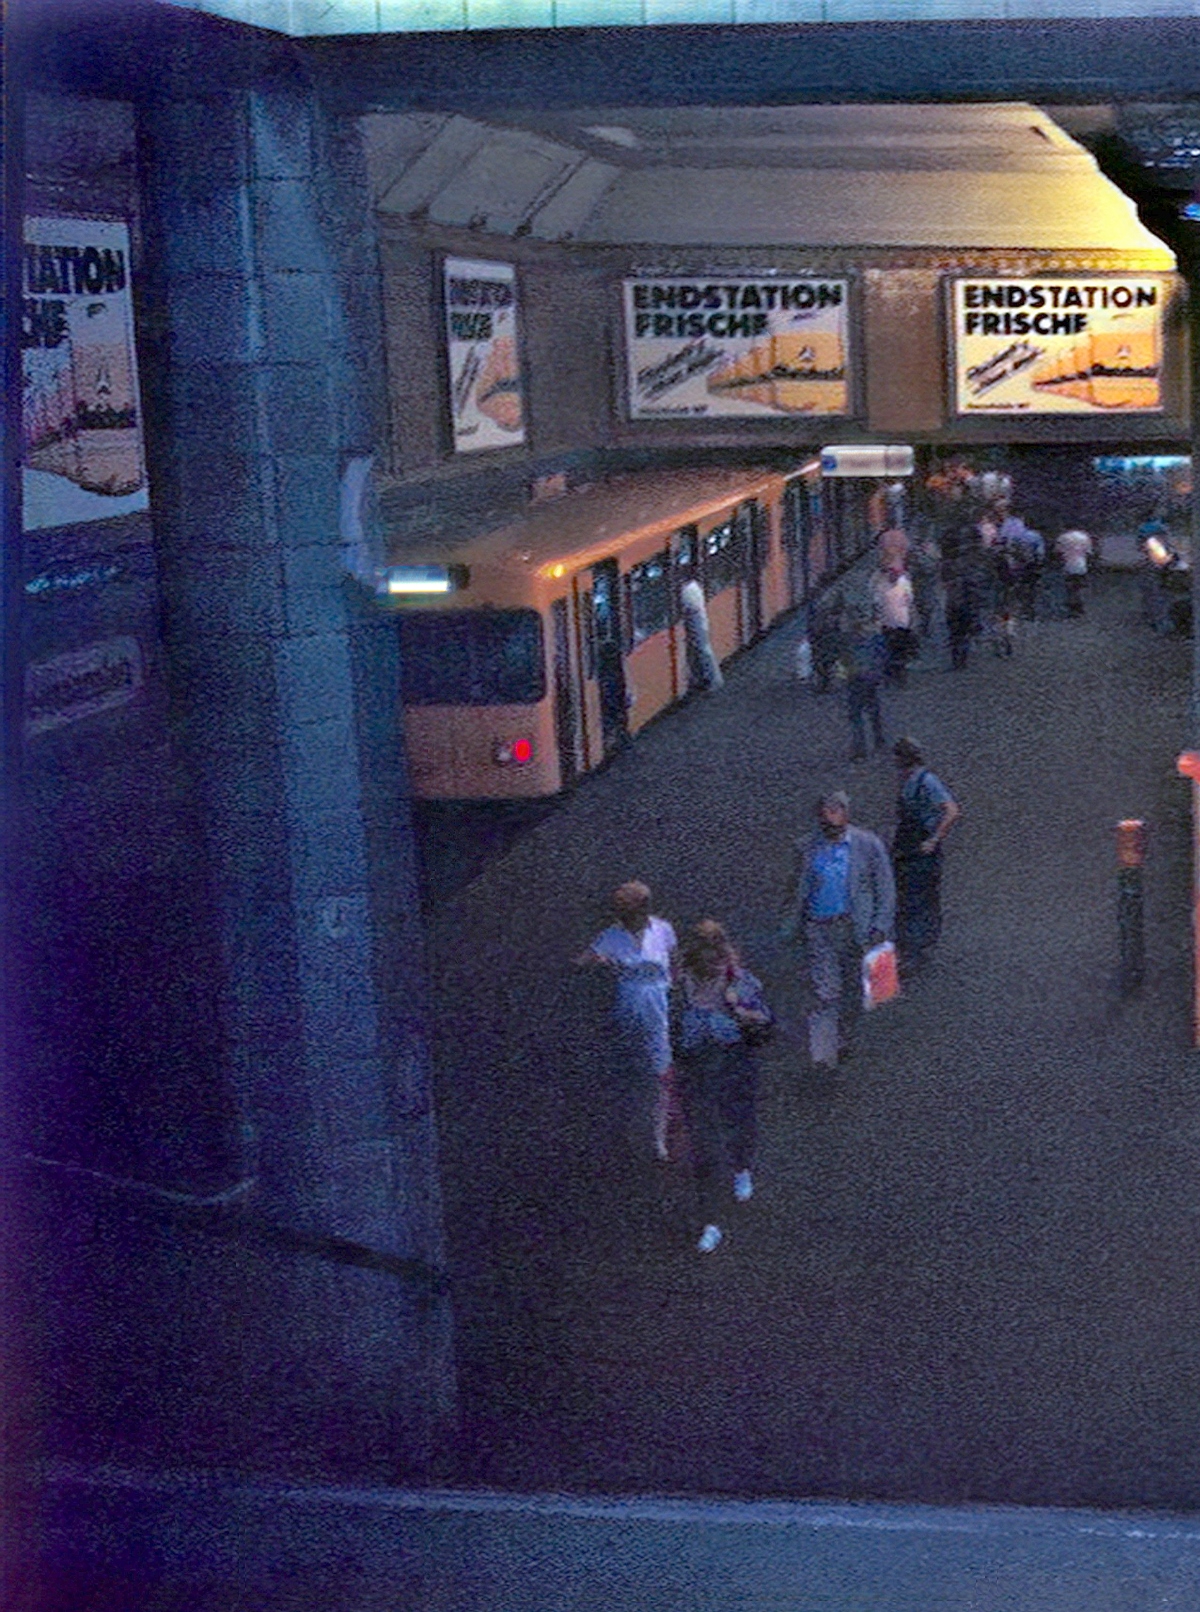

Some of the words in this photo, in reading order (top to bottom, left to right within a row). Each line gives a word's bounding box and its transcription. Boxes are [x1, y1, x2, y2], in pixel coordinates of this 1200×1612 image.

[633, 284, 843, 309] ENDSTATION
[964, 285, 1157, 309] ENDSTATION
[634, 312, 770, 338] FRISCHE
